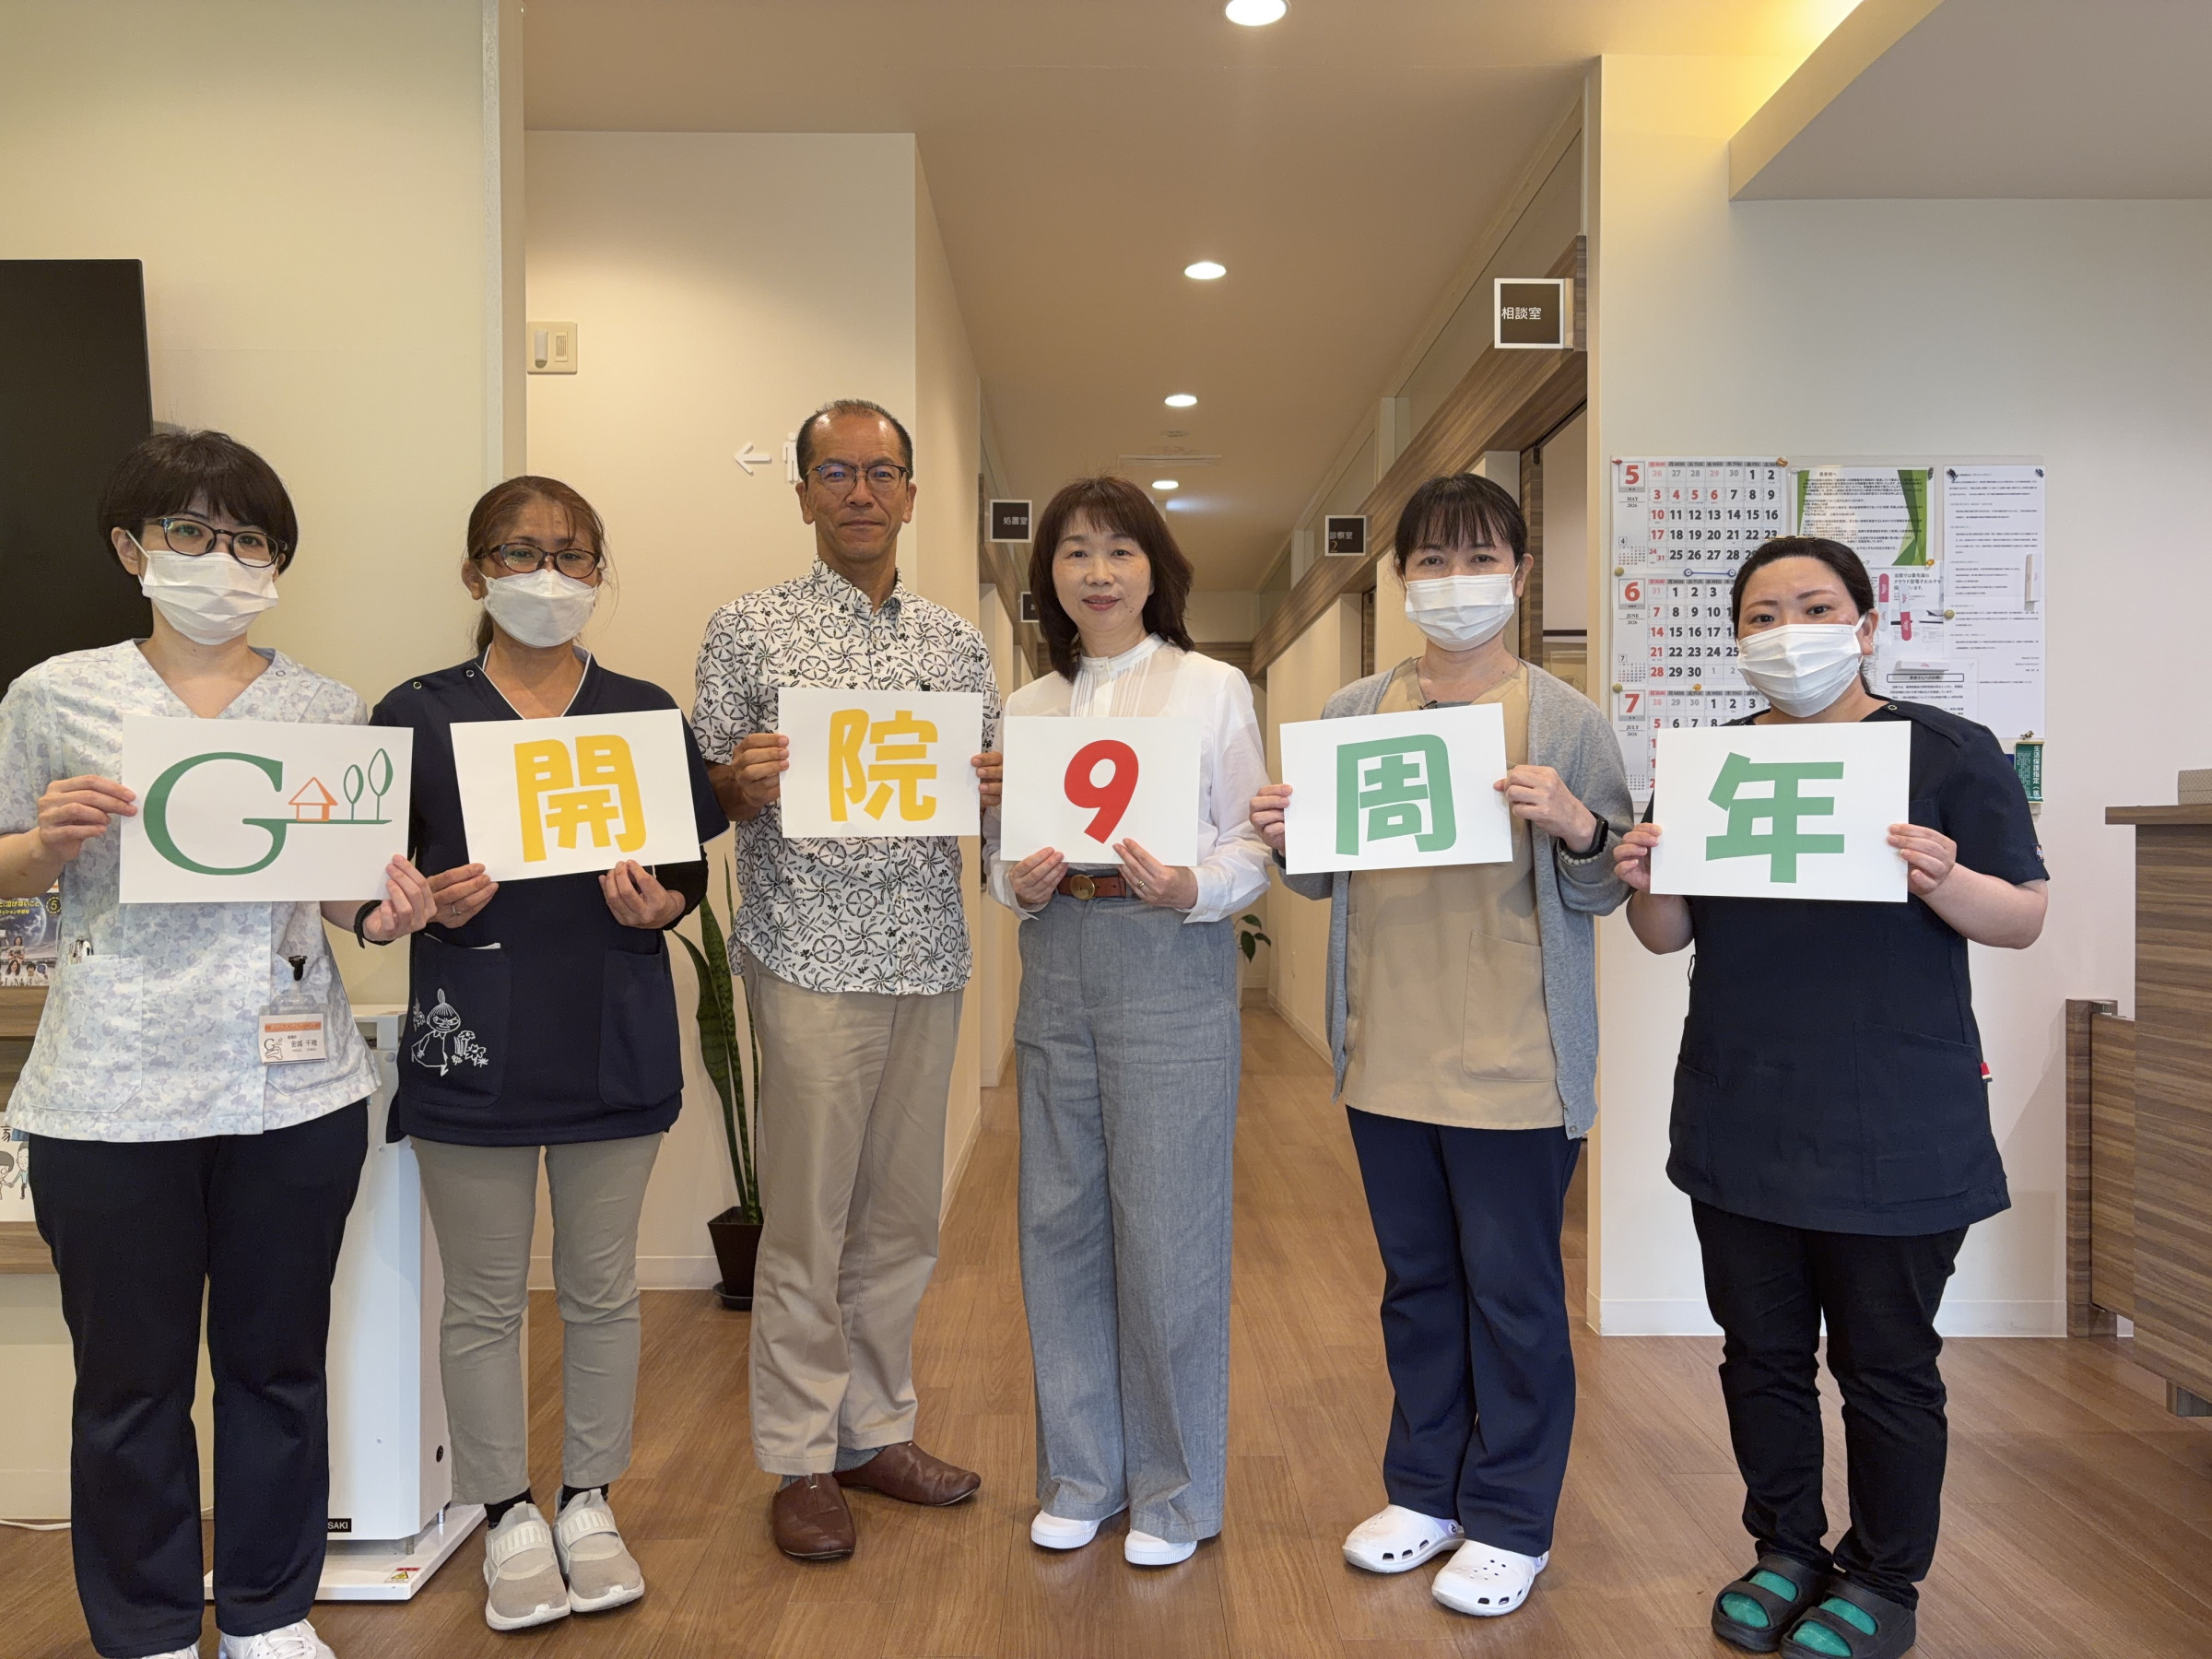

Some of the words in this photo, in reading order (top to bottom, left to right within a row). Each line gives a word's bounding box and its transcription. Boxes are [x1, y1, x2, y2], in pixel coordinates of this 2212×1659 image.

[1501, 307, 1541, 320] 相談室
[1626, 465, 1639, 485] 5
[1750, 470, 1754, 479] 1
[1768, 470, 1774, 479] 2
[1654, 489, 1661, 500] 3
[1673, 490, 1679, 500] 4
[1692, 490, 1698, 500] 5
[1711, 490, 1718, 500] 6
[1731, 489, 1737, 500] 7
[1749, 489, 1756, 500] 8
[1768, 490, 1774, 500] 9
[1652, 510, 1664, 519] 10
[1670, 510, 1681, 520] 11
[1688, 510, 1701, 520] 12
[1708, 510, 1721, 520] 13
[1728, 510, 1740, 519] 14
[1747, 510, 1759, 520] 15
[1766, 510, 1778, 520] 16
[1003, 517, 1028, 525] 処置室
[1329, 532, 1353, 540] 診察室
[1652, 530, 1664, 539] 17
[1670, 530, 1683, 539] 18
[1689, 530, 1701, 539] 19
[1707, 530, 1721, 540] 20
[1727, 530, 1738, 539] 21
[1746, 530, 1759, 540] 22
[1764, 530, 1777, 539] 23
[1330, 540, 1338, 553] 2
[1670, 550, 1683, 559] 25
[1688, 550, 1701, 559] 26
[1707, 550, 1721, 559] 27
[1726, 550, 1739, 559] 28
[1625, 582, 1640, 601] 6
[1673, 587, 1677, 596] 1
[1691, 587, 1698, 596] 2
[1711, 587, 1716, 596] 3
[1653, 607, 1660, 617] 7
[1673, 607, 1679, 617] 8
[1691, 607, 1698, 617] 9
[1708, 607, 1720, 617] 10
[1651, 628, 1664, 637] 14
[1670, 628, 1682, 637] 15
[1688, 627, 1701, 637] 16
[1708, 627, 1721, 637] 17
[1651, 647, 1662, 656] 21
[1669, 647, 1682, 656] 22
[1688, 647, 1700, 656] 23
[1707, 647, 1721, 656] 24
[1726, 647, 1739, 656] 25
[1651, 667, 1664, 677] 28
[1669, 667, 1682, 677] 29
[1688, 667, 1701, 677] 30
[1625, 694, 1640, 712] 7
[1712, 699, 1715, 708] 1
[1730, 699, 1736, 708] 2
[1749, 699, 1756, 708] 3
[1654, 719, 1660, 728] 5
[1673, 719, 1679, 728] 6
[1691, 719, 1698, 727] 7
[830, 708, 937, 821] 院
[1064, 739, 1139, 844] 9
[1335, 734, 1456, 855] 周
[513, 734, 647, 863] 開
[143, 751, 288, 876] G
[1705, 751, 1844, 883] 年
[51, 900, 57, 911] 5
[327, 1521, 348, 1530] SAKI
